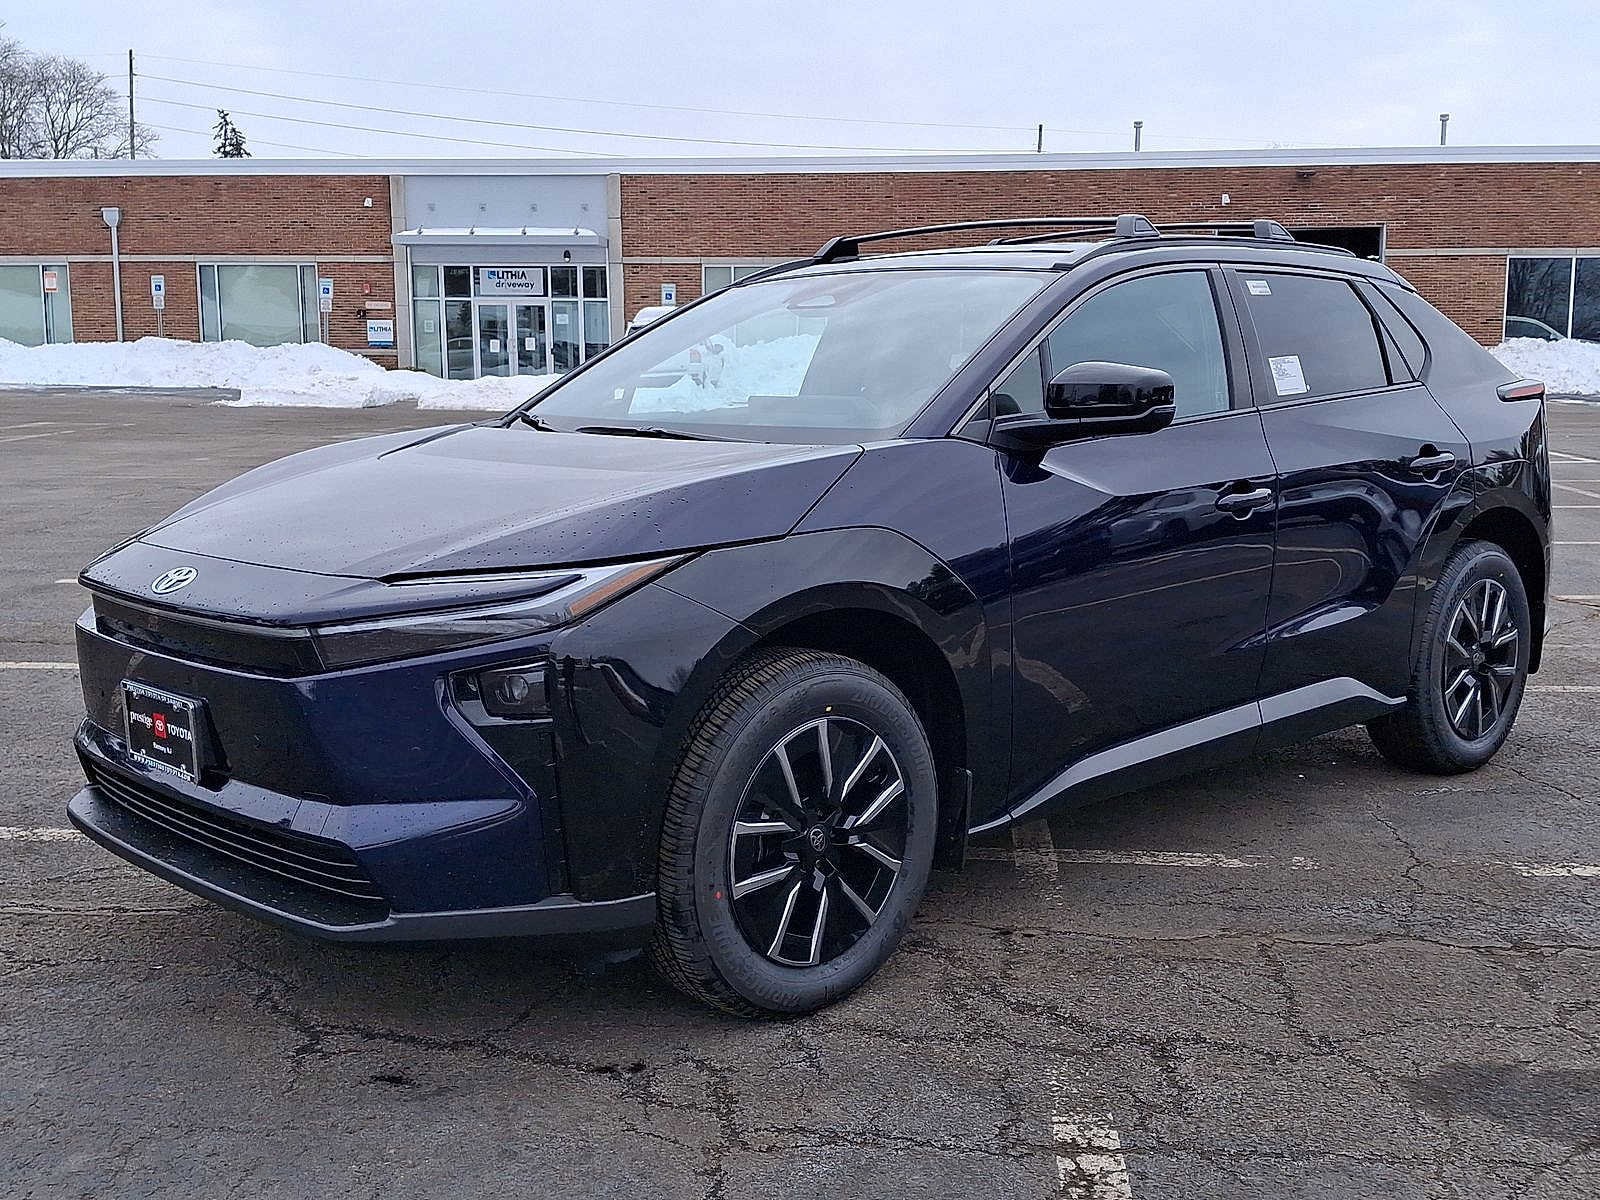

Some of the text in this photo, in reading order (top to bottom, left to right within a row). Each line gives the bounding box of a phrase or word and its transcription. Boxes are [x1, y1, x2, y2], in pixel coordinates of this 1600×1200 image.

[497, 270, 527, 280] LITHIA
[130, 711, 153, 729] prestige
[166, 723, 192, 741] TOYOTA
